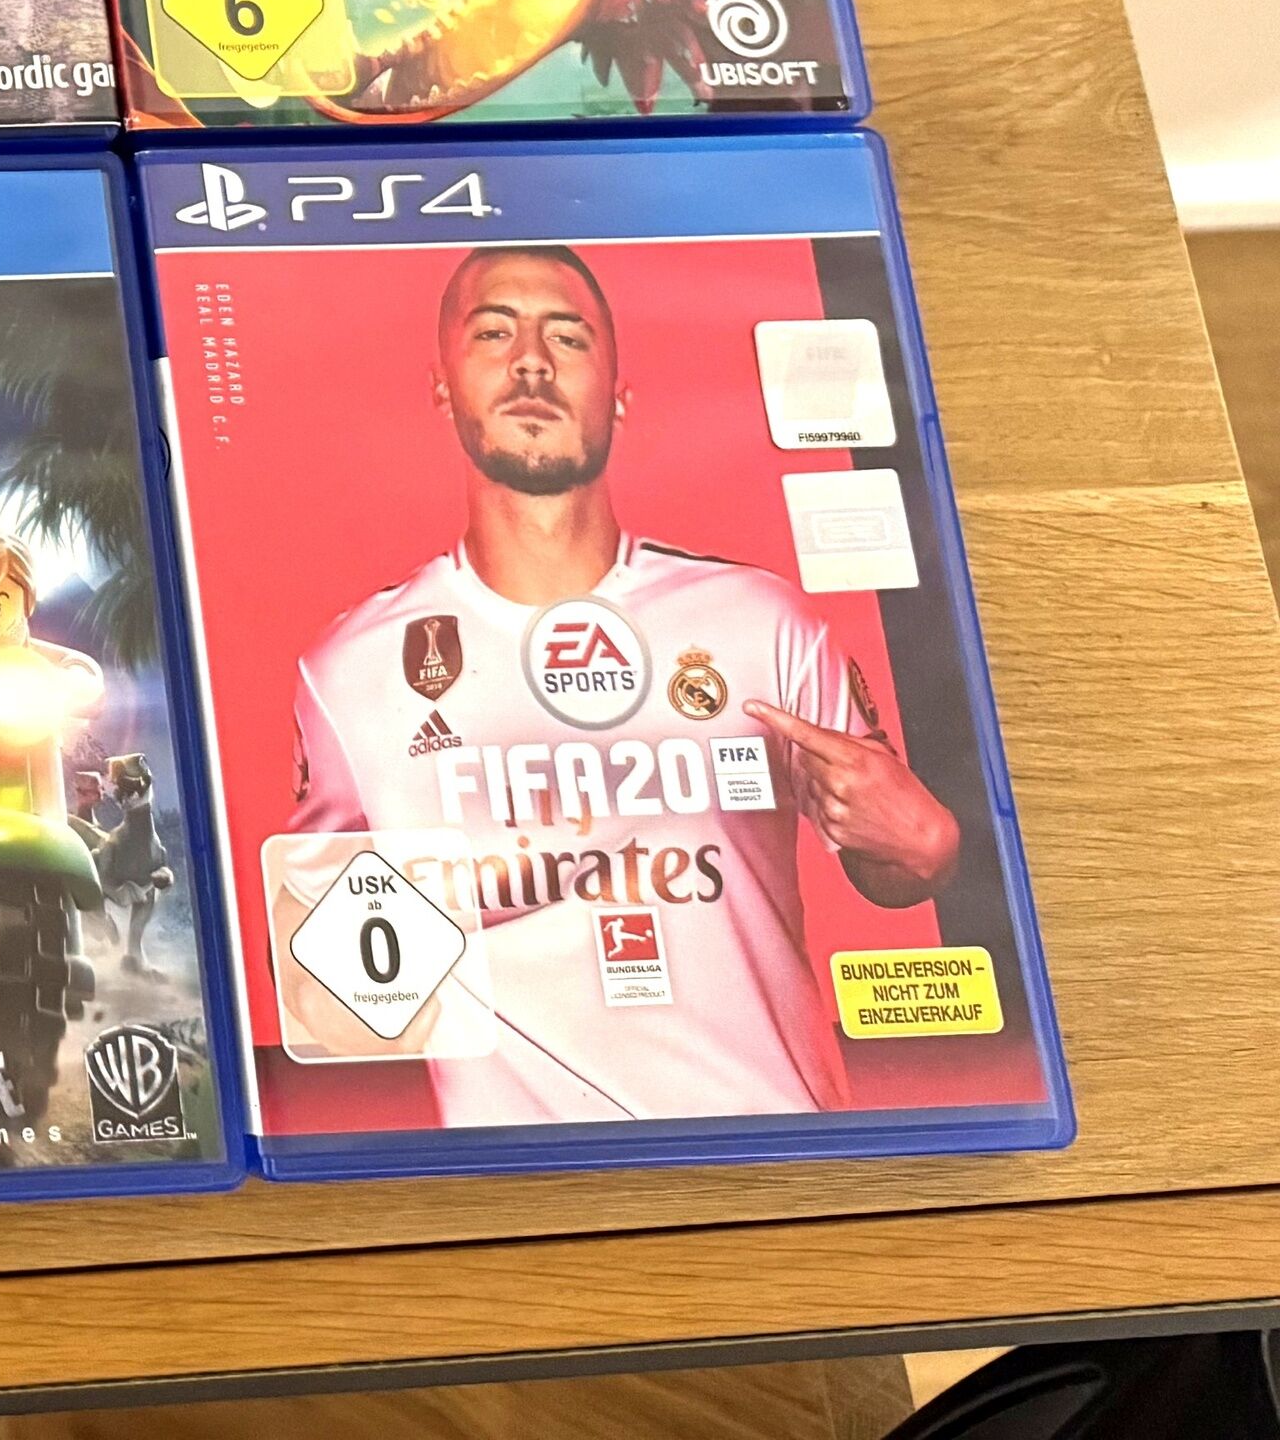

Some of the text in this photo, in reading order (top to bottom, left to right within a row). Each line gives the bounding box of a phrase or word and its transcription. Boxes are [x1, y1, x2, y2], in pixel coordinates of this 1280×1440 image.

[218, 41, 280, 54] freigegeben
[699, 61, 819, 87] UBISOFT
[288, 172, 492, 222] PS4
[195, 283, 214, 326] REAL
[215, 283, 245, 405] EDEN HAZARD
[202, 336, 224, 404] MADRID
[544, 622, 631, 670] EA
[419, 664, 448, 681] FIFA
[544, 669, 636, 694] SPORTS
[408, 733, 463, 758] adidas
[718, 746, 759, 763] FIFA
[347, 874, 398, 896] USK
[367, 899, 383, 911] ab
[359, 916, 401, 985] 0
[606, 964, 662, 974] BUNDESLIGA
[840, 959, 973, 981] BUNDLEVERSION
[353, 990, 420, 1006] freigegeben
[872, 982, 960, 1002] NICHT ZUM
[857, 1003, 984, 1025] EINZELVERKAUF
[97, 1116, 181, 1139] GAMES
